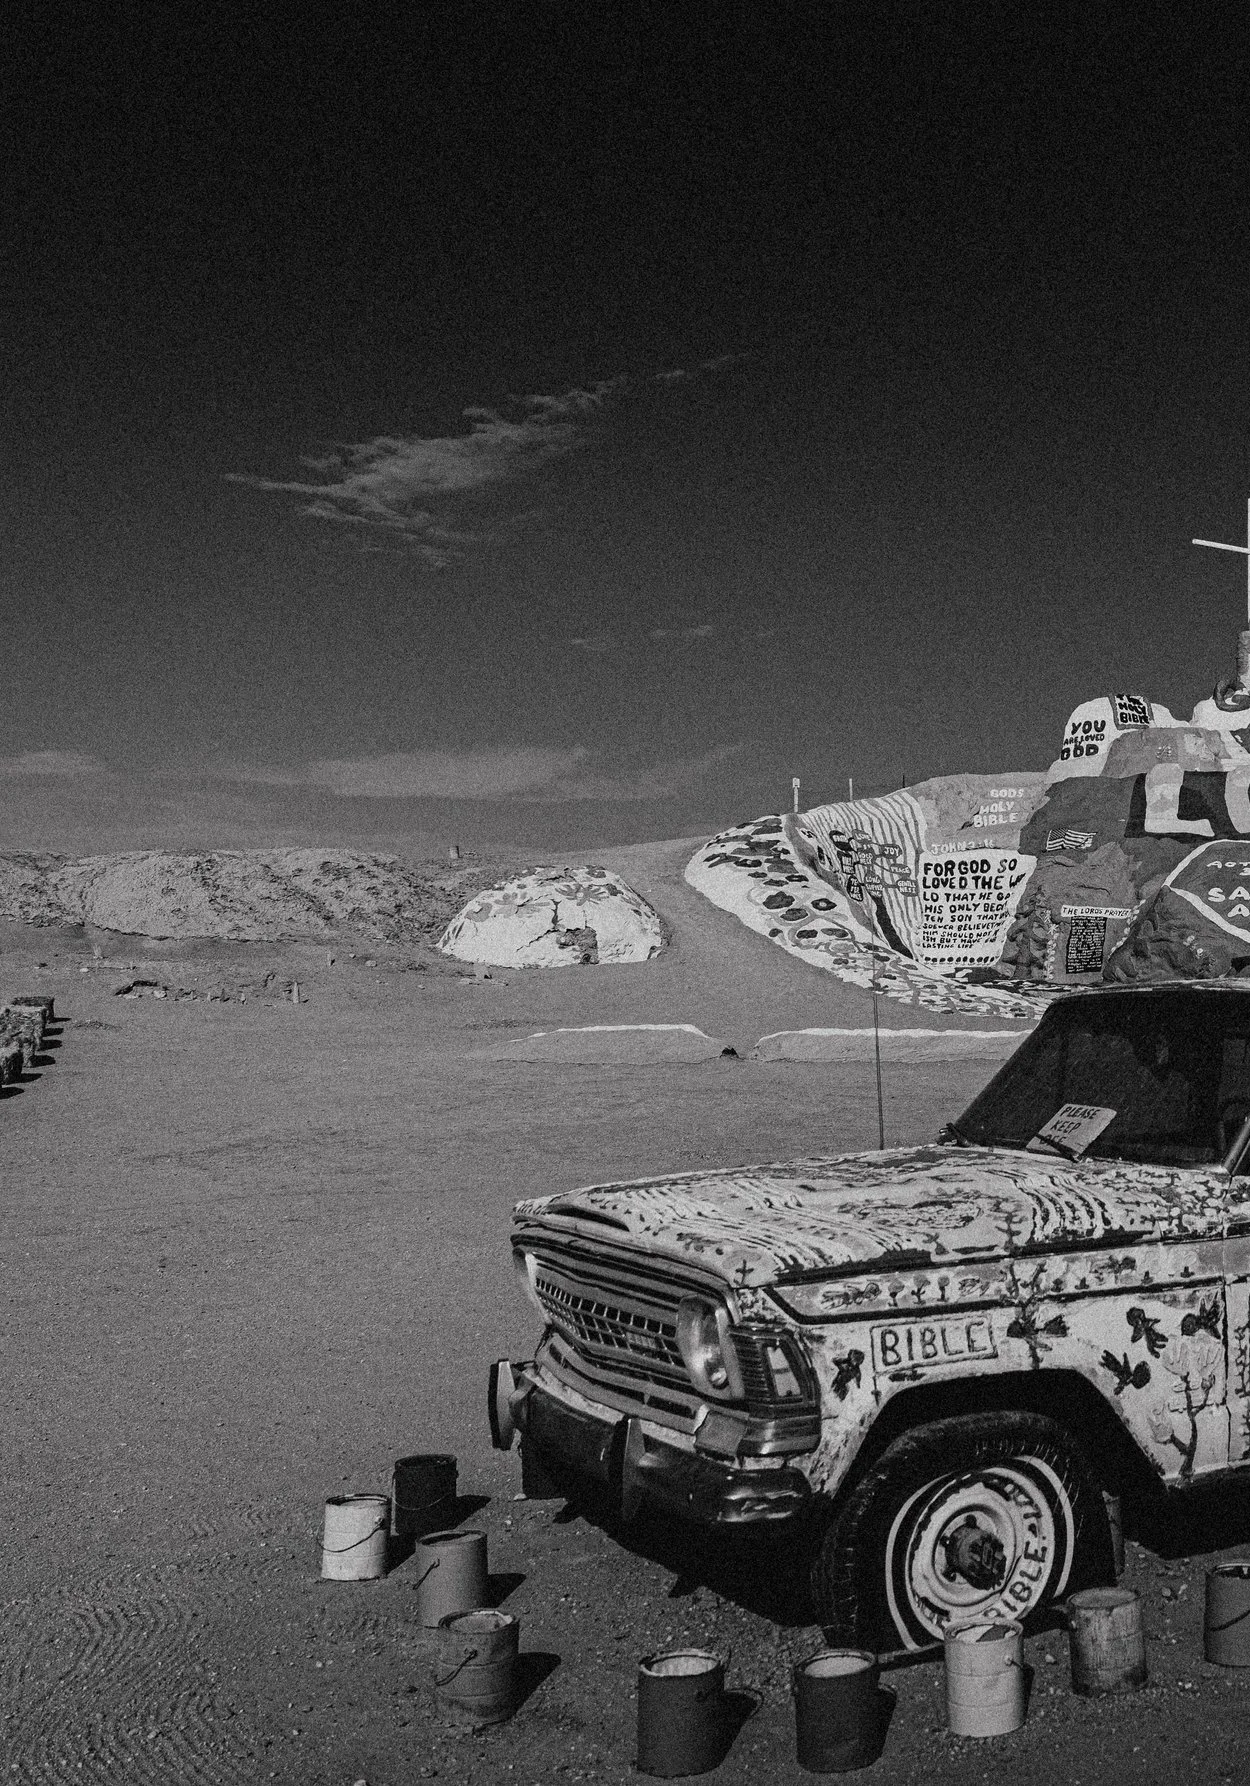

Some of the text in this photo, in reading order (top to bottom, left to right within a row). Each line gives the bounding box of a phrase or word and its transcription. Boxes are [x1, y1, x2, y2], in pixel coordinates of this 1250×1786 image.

[1071, 720, 1105, 735] YOU
[1080, 733, 1104, 743] LOVED
[990, 788, 1024, 798] GODS
[980, 801, 1014, 814] HOLY
[974, 812, 1018, 828] BIBLE
[884, 846, 900, 856] JOY
[931, 841, 966, 855] JOHN
[997, 858, 1017, 873] SO
[922, 876, 968, 889] LOVED
[971, 875, 1004, 890] THE
[923, 891, 939, 902] LD
[944, 893, 976, 902] THAT
[979, 892, 993, 900] HE
[924, 904, 944, 914] HIS
[949, 903, 980, 913] ONLY
[1062, 907, 1129, 917] THE LORDS PRAYER
[1227, 904, 1250, 917] A
[924, 914, 943, 923] TEN
[950, 914, 972, 922] SON
[940, 931, 974, 939] SHOULD
[976, 930, 992, 939] NOT
[1060, 1106, 1101, 1119] PLEASE
[1050, 1119, 1081, 1134] KEEP
[881, 1321, 988, 1367] BIBLE
